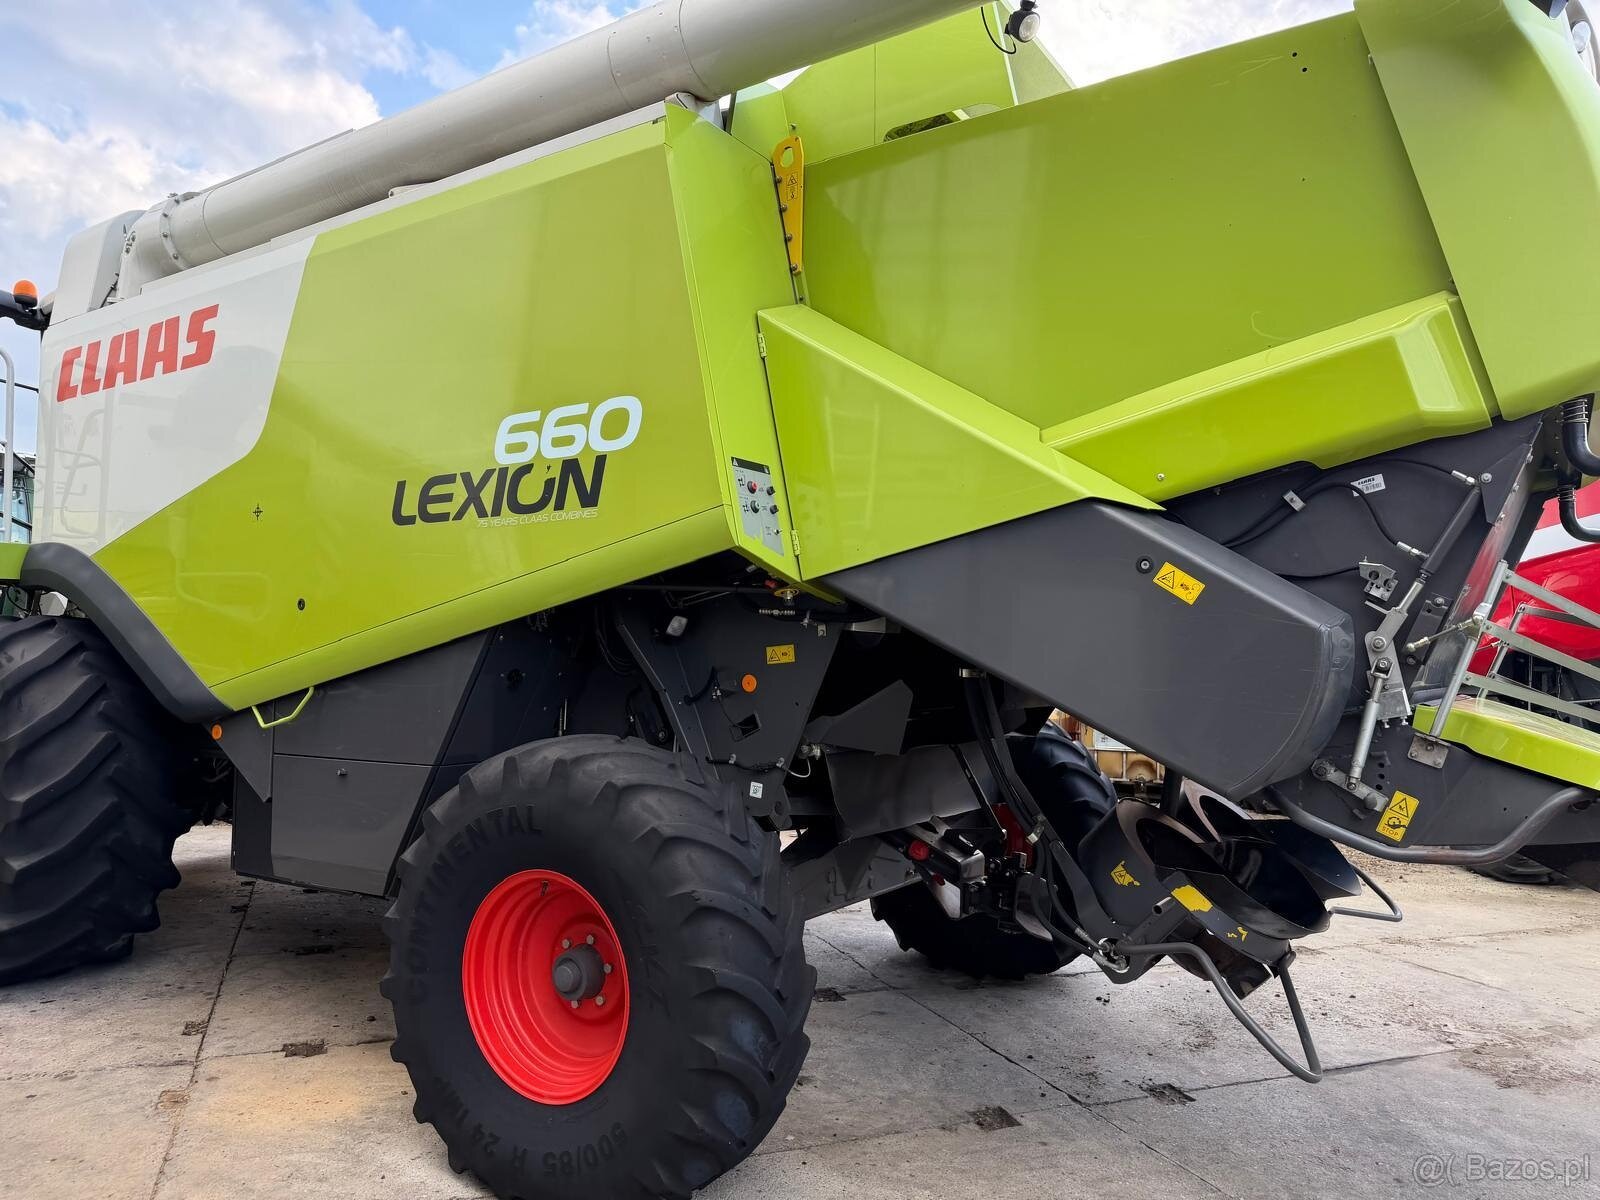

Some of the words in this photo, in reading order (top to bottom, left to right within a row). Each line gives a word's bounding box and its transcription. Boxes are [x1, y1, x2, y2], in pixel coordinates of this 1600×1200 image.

[57, 303, 219, 403] CLAAS
[494, 395, 643, 465] 660
[392, 453, 608, 526] LEXION
[476, 518, 489, 528] 75
[489, 516, 518, 527] YEARS
[519, 512, 549, 525] CLAAS
[549, 508, 599, 522] COMBINES
[1381, 826, 1399, 836] STOP
